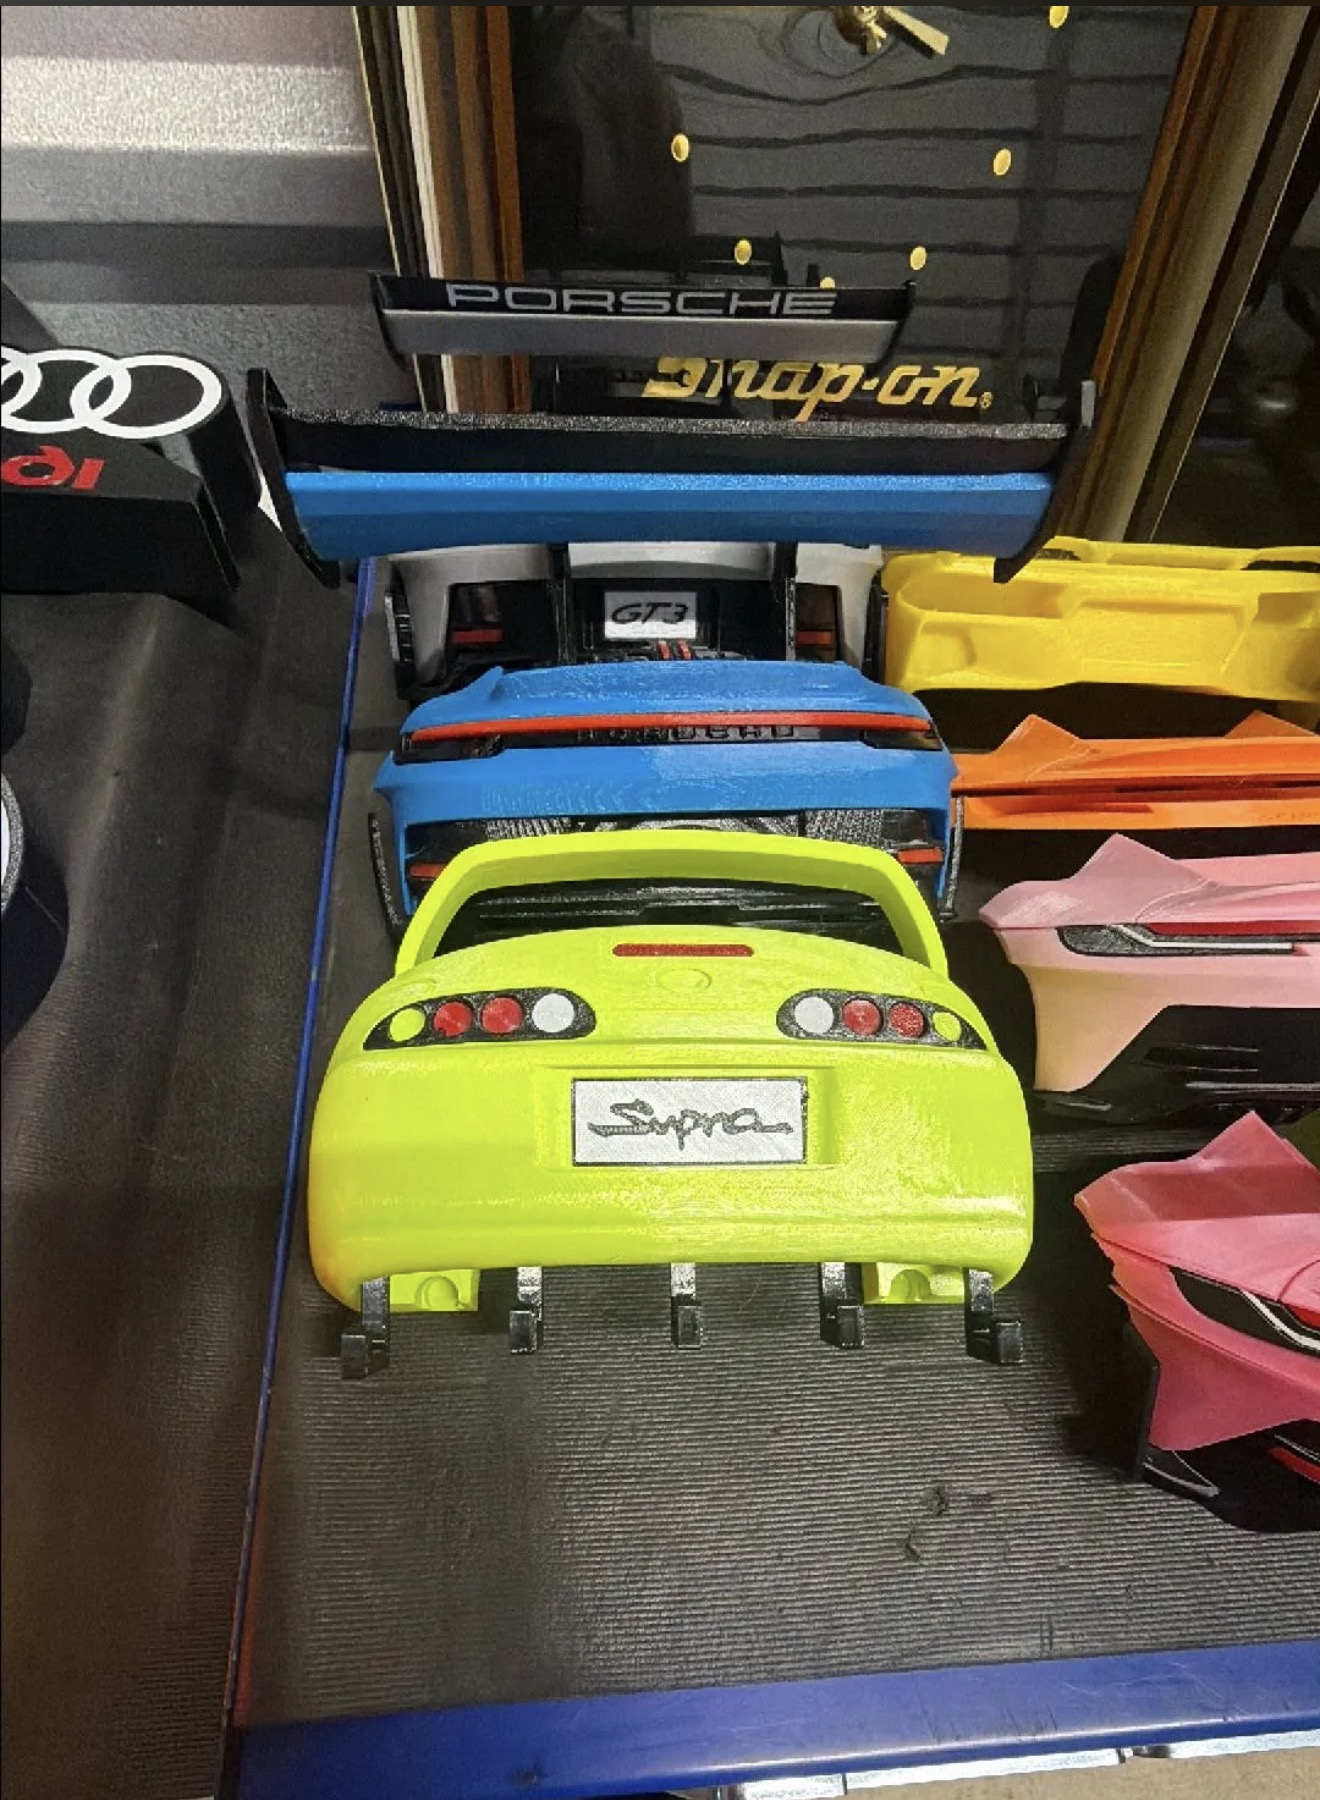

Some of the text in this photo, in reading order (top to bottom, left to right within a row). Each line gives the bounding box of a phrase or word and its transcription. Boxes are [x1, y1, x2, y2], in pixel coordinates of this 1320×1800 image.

[446, 283, 838, 315] PORSCHE
[611, 601, 688, 625] GT3
[587, 1098, 794, 1151] Supra
